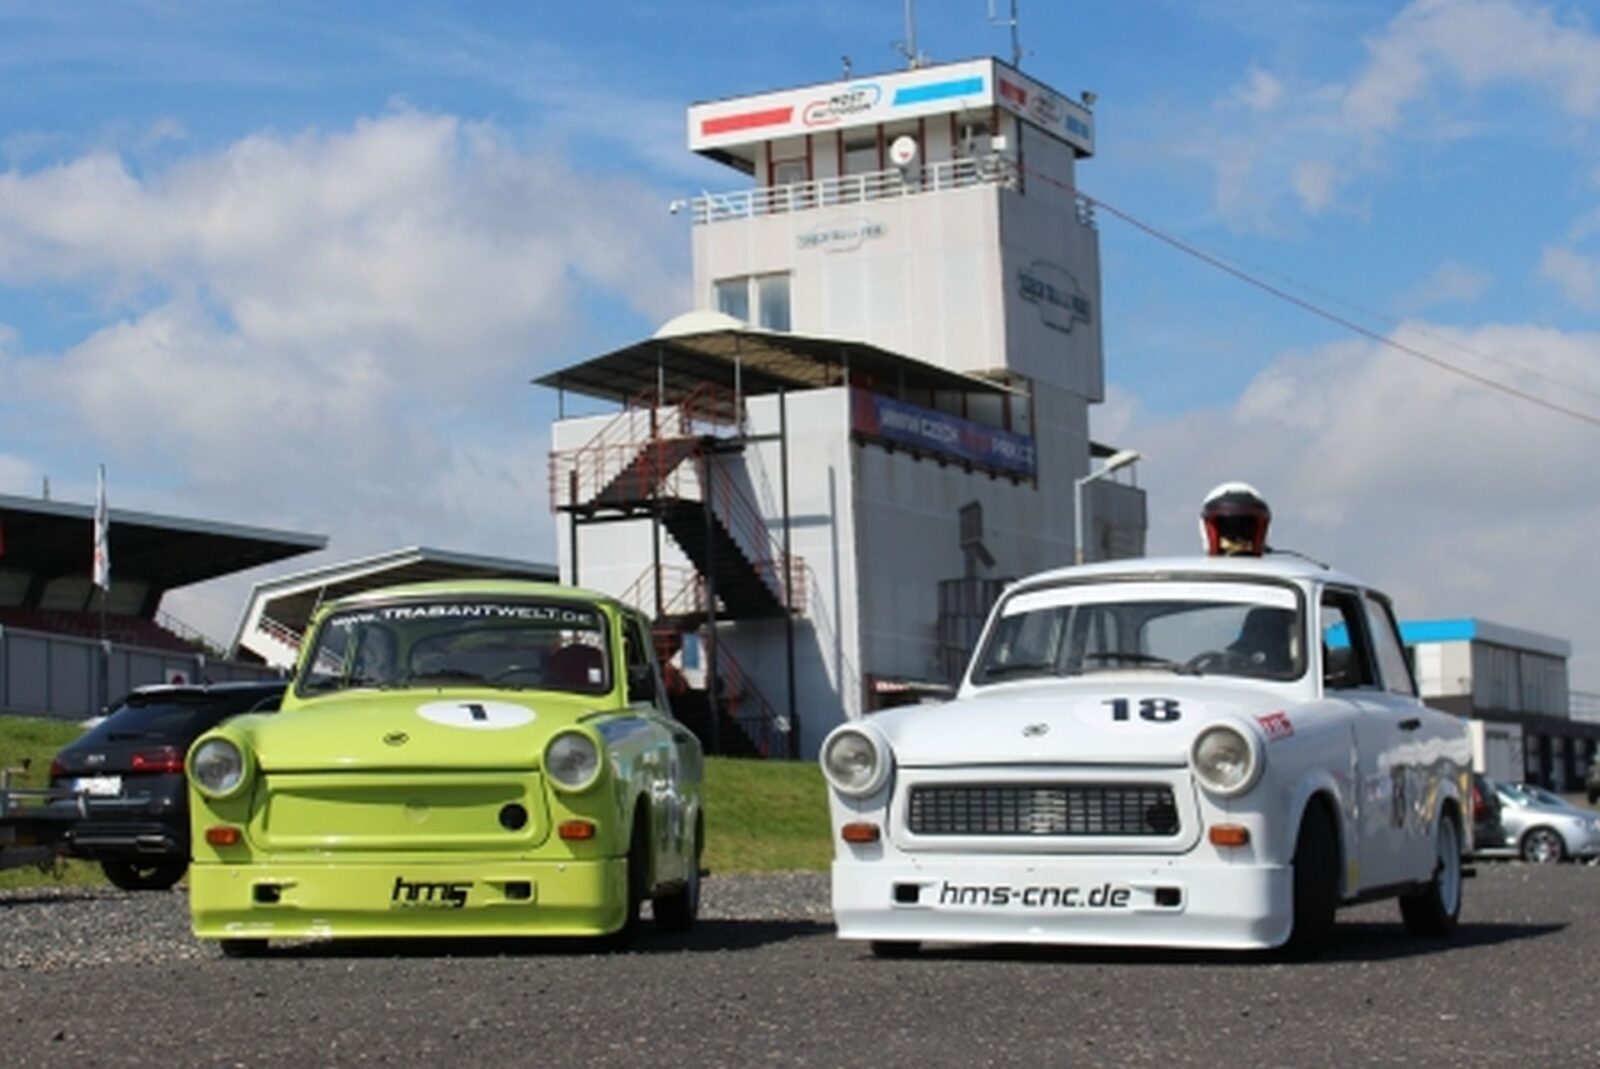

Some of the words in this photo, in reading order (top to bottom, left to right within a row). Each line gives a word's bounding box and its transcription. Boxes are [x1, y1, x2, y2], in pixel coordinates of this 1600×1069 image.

[458, 703, 488, 721] 1
[1101, 697, 1182, 723] 18
[392, 877, 474, 908] hms
[939, 881, 1131, 907] hms-cnc.de
